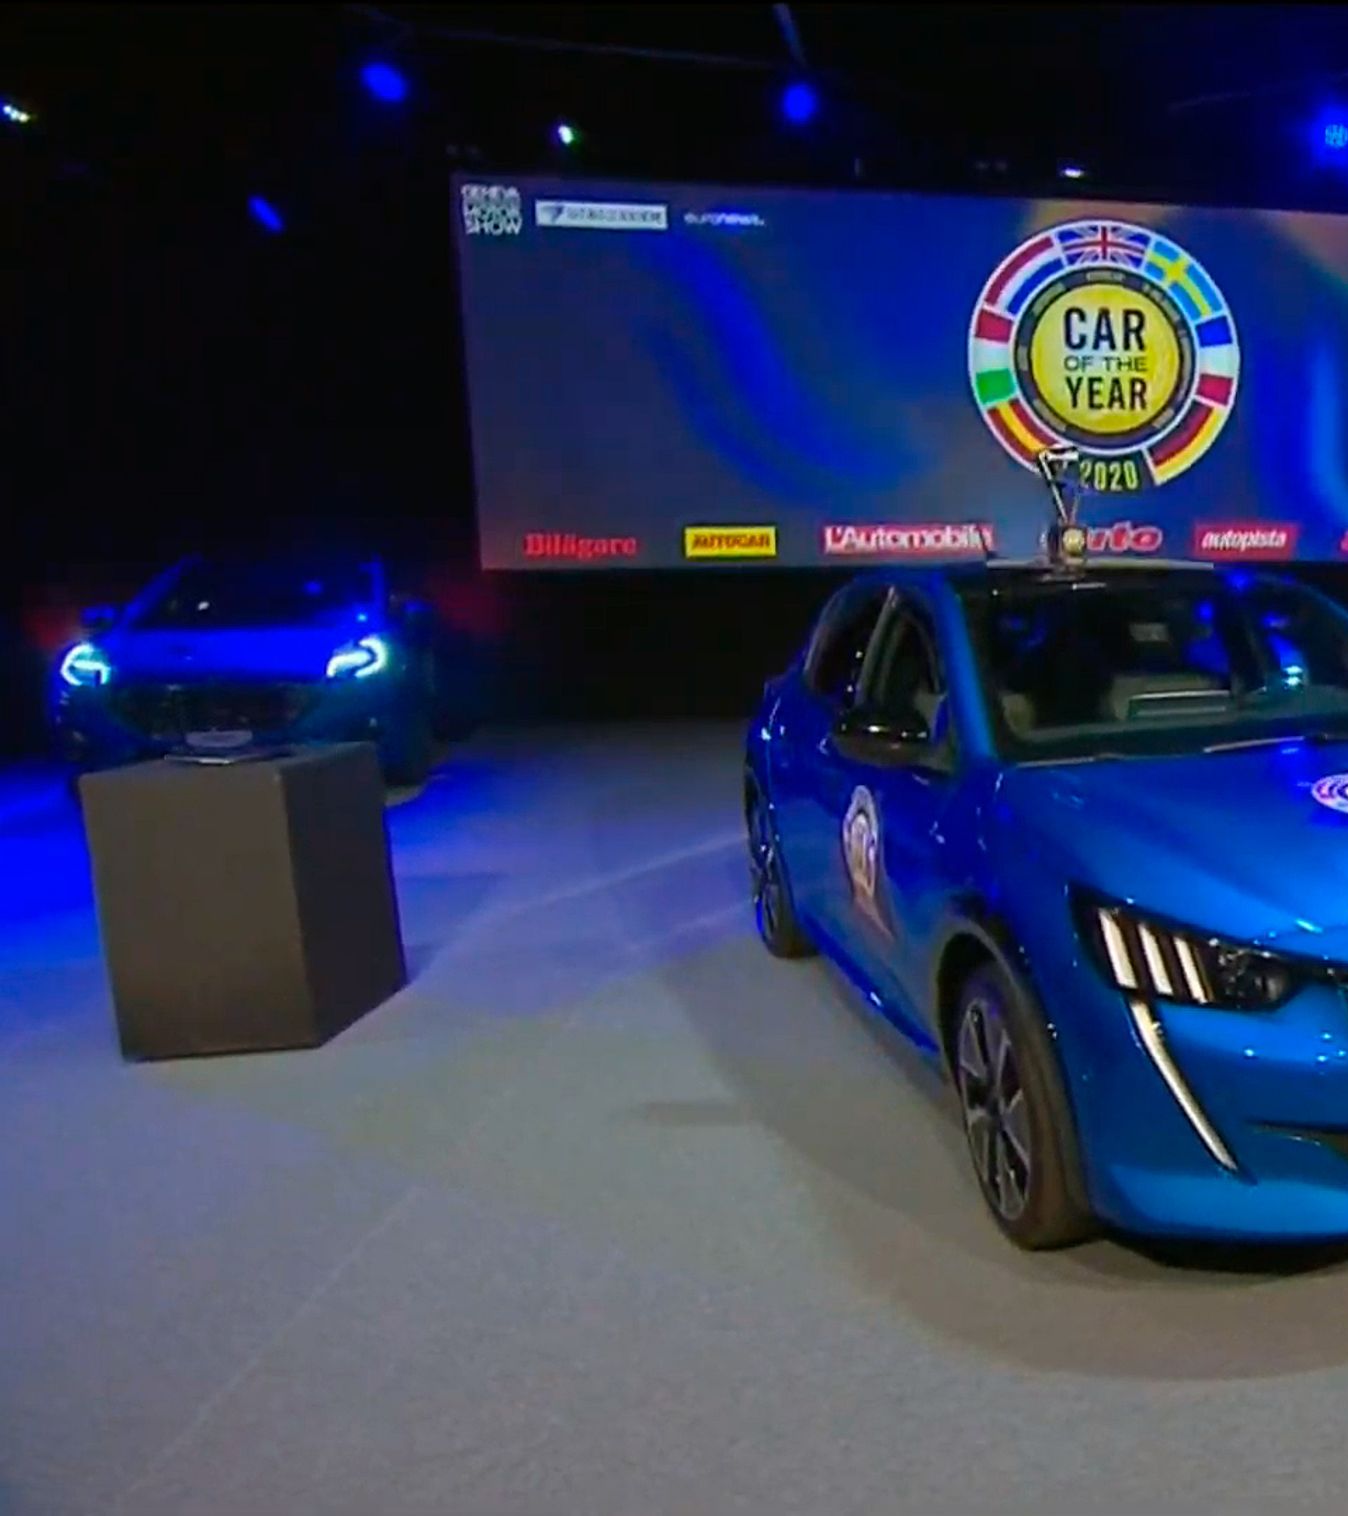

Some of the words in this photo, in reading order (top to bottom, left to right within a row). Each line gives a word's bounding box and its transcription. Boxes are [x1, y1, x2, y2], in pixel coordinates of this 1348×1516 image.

[1064, 307, 1145, 351] CAR
[1064, 355, 1093, 372] OF
[1103, 356, 1148, 372] THE
[1065, 377, 1147, 410] YEAR
[1079, 460, 1139, 491] 2020
[1201, 528, 1288, 551] autopista
